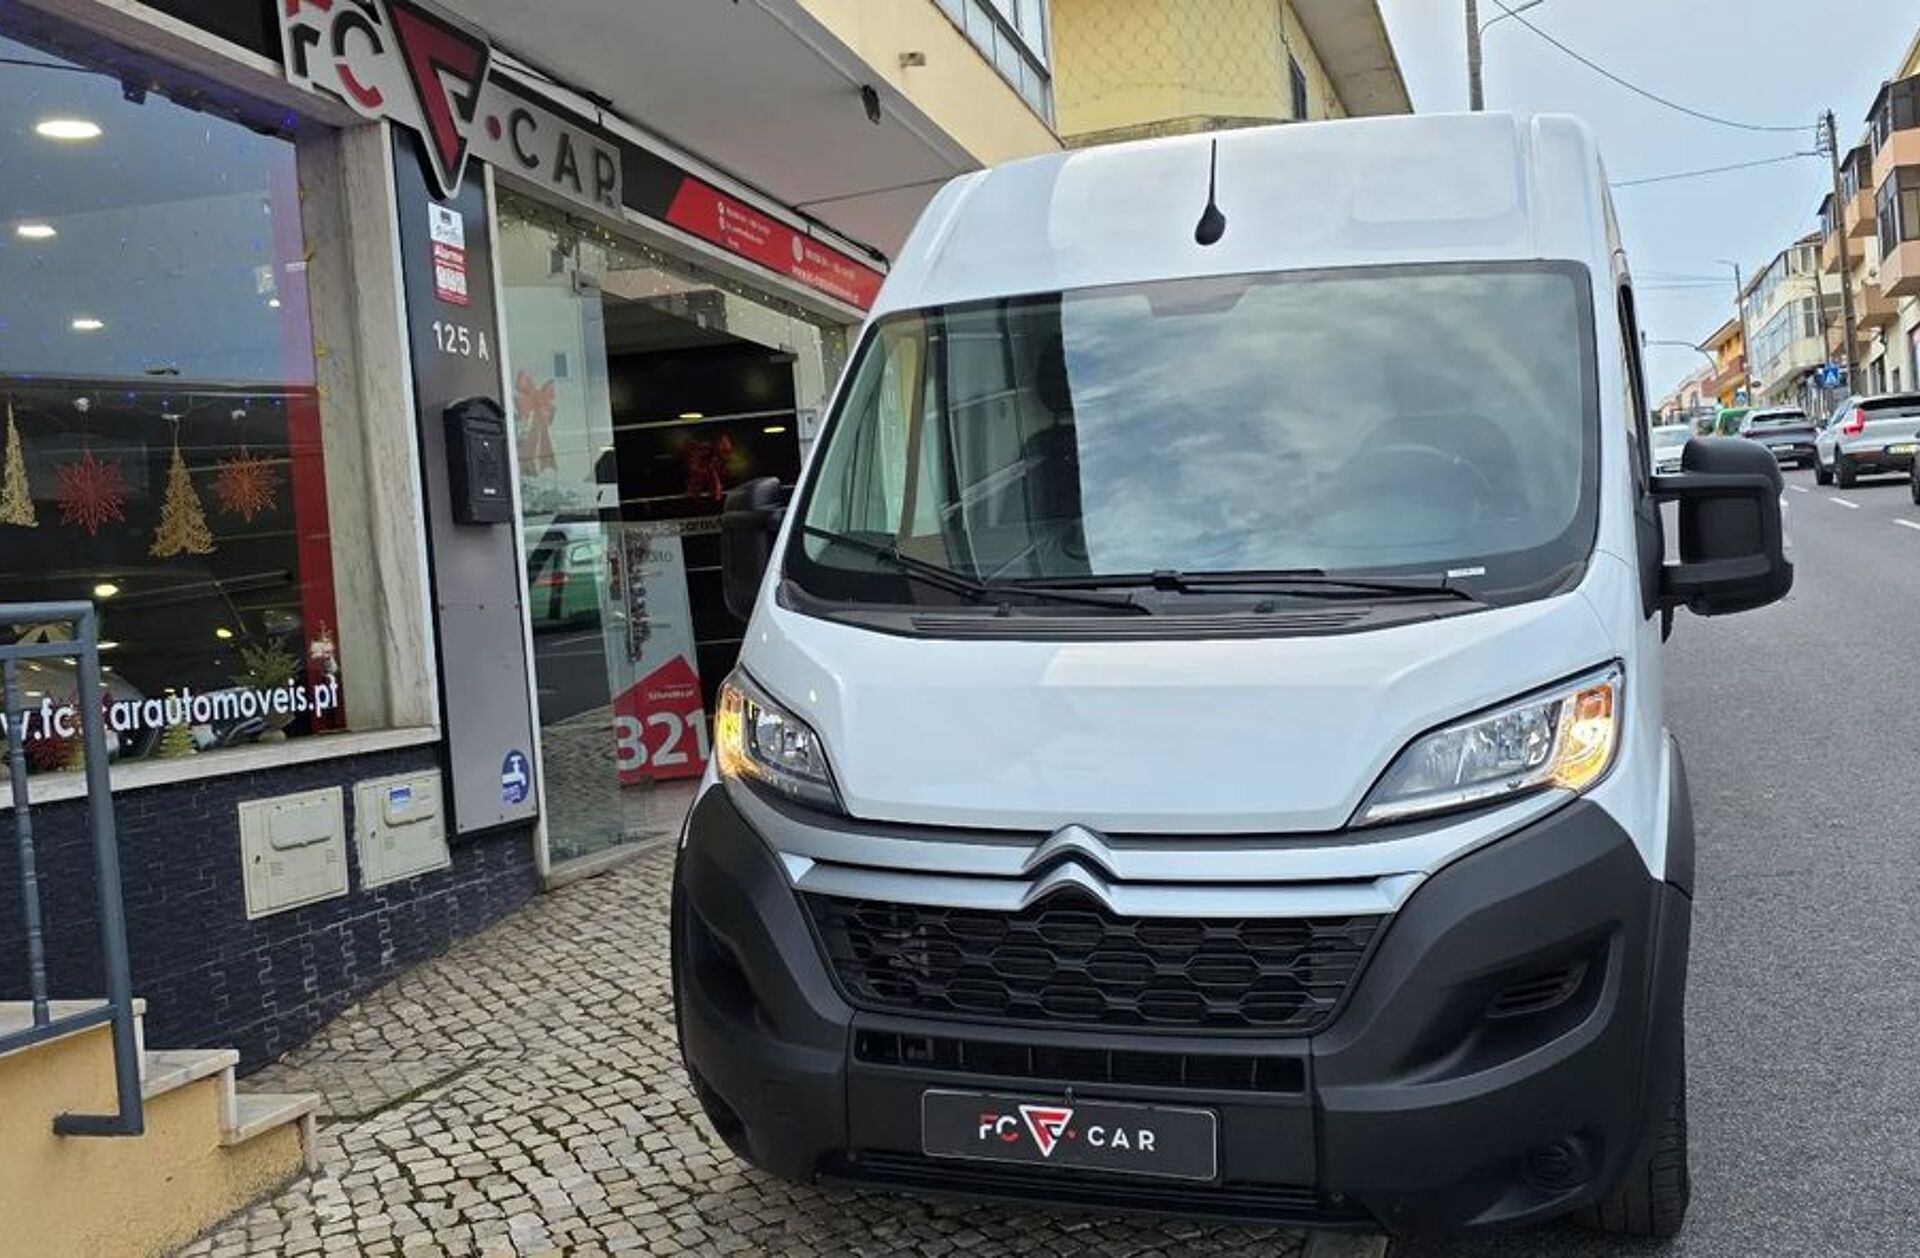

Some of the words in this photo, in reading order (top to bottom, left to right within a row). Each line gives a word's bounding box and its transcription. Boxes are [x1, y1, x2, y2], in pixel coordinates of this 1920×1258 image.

[509, 107, 615, 209] CAR
[432, 321, 470, 356] 125
[478, 331, 489, 361] A
[615, 707, 710, 771] 321
[979, 1114, 1018, 1142] FC
[1087, 1126, 1156, 1151] CAR
